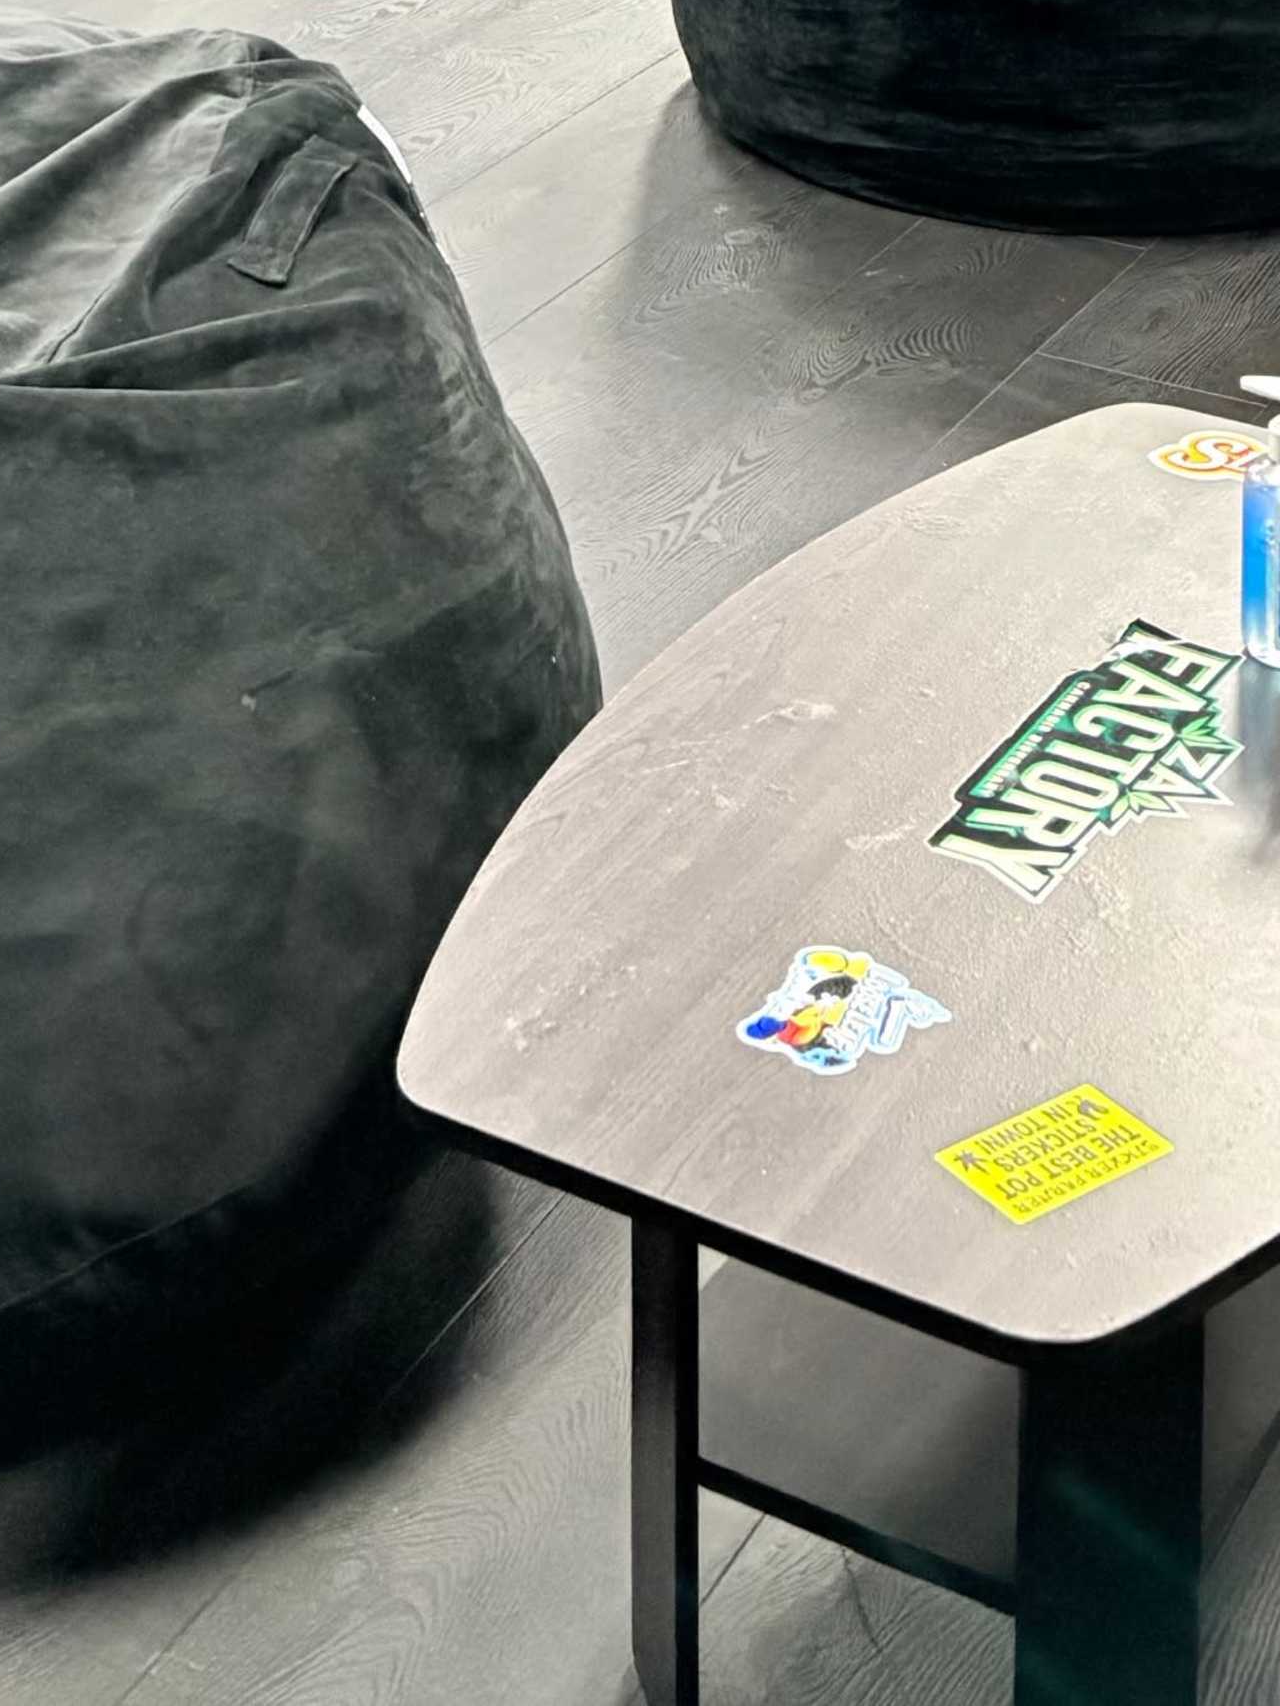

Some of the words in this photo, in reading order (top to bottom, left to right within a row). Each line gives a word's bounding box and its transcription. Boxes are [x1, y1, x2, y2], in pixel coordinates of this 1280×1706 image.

[938, 627, 1234, 892] FACTORY
[1132, 741, 1230, 797] ZA
[1041, 1101, 1075, 1124] IN
[973, 1116, 1049, 1155] TOWN!
[992, 1118, 1098, 1173] STICKERS
[1090, 1123, 1142, 1155] THE
[1038, 1143, 1098, 1180] BEST
[995, 1169, 1044, 1201] POT
